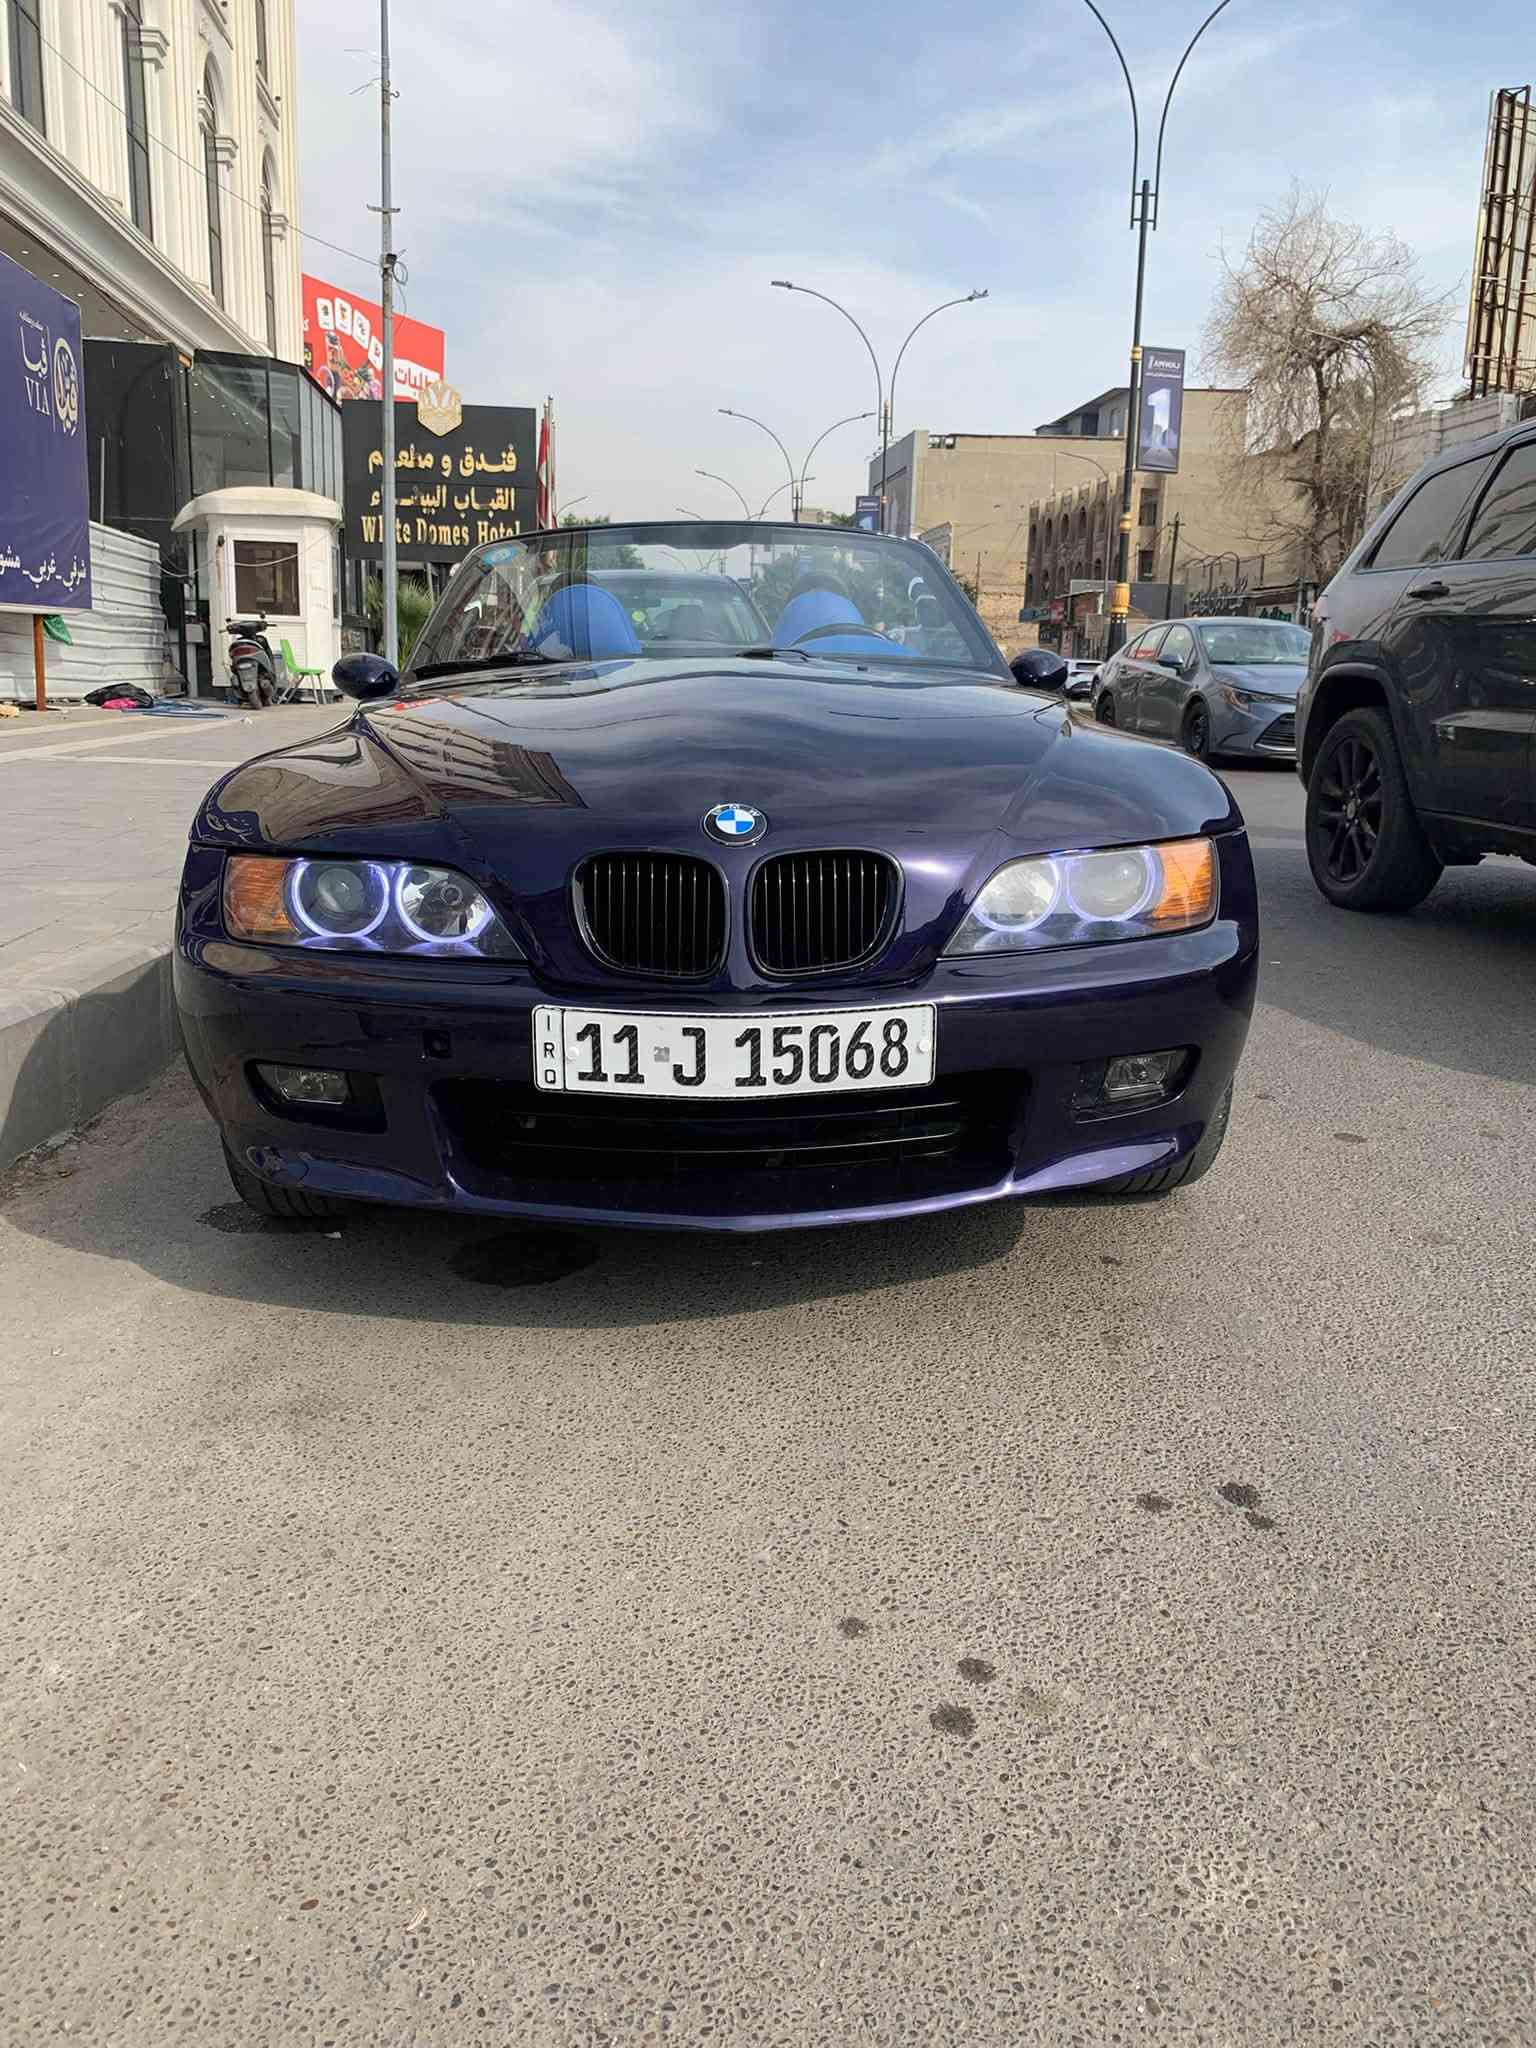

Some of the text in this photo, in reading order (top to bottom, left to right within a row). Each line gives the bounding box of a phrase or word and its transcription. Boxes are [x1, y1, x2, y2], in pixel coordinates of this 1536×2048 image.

[25, 375, 50, 416] VIA
[441, 454, 452, 477] و
[460, 444, 517, 477] فندق
[454, 486, 515, 519] القباب
[361, 514, 411, 545] Wte
[416, 518, 470, 546] Domes
[576, 1023, 644, 1084] 11
[673, 1027, 706, 1086] J
[735, 1018, 909, 1087] 15068
